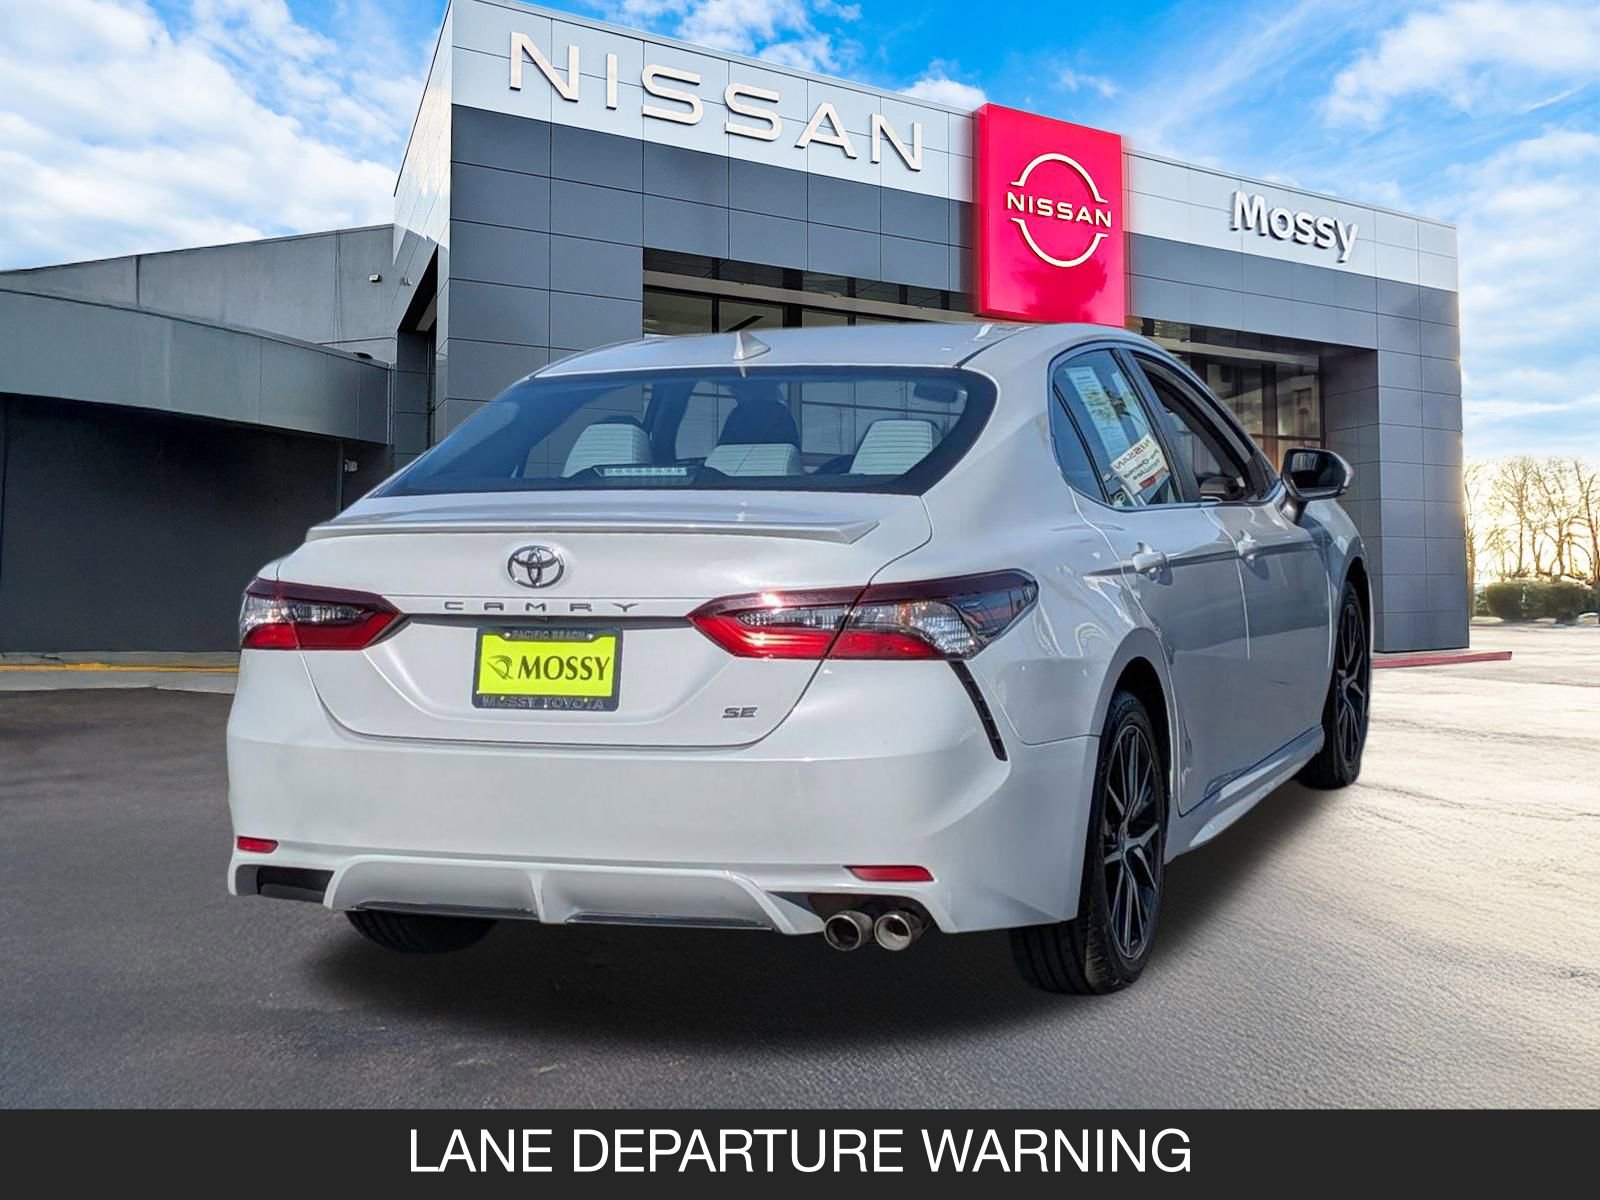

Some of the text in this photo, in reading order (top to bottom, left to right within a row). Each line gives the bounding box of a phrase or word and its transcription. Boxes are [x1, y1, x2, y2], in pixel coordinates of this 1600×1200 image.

[509, 31, 922, 171] NISSAN
[1007, 191, 1112, 228] NISSAN
[1231, 189, 1360, 263] Mossy
[444, 602, 639, 613] CAMRY
[511, 630, 586, 641] PACIFIC BEACH
[518, 655, 611, 681] MOSSY
[482, 695, 604, 710] MOSSY TOYOTA
[722, 707, 758, 718] SE
